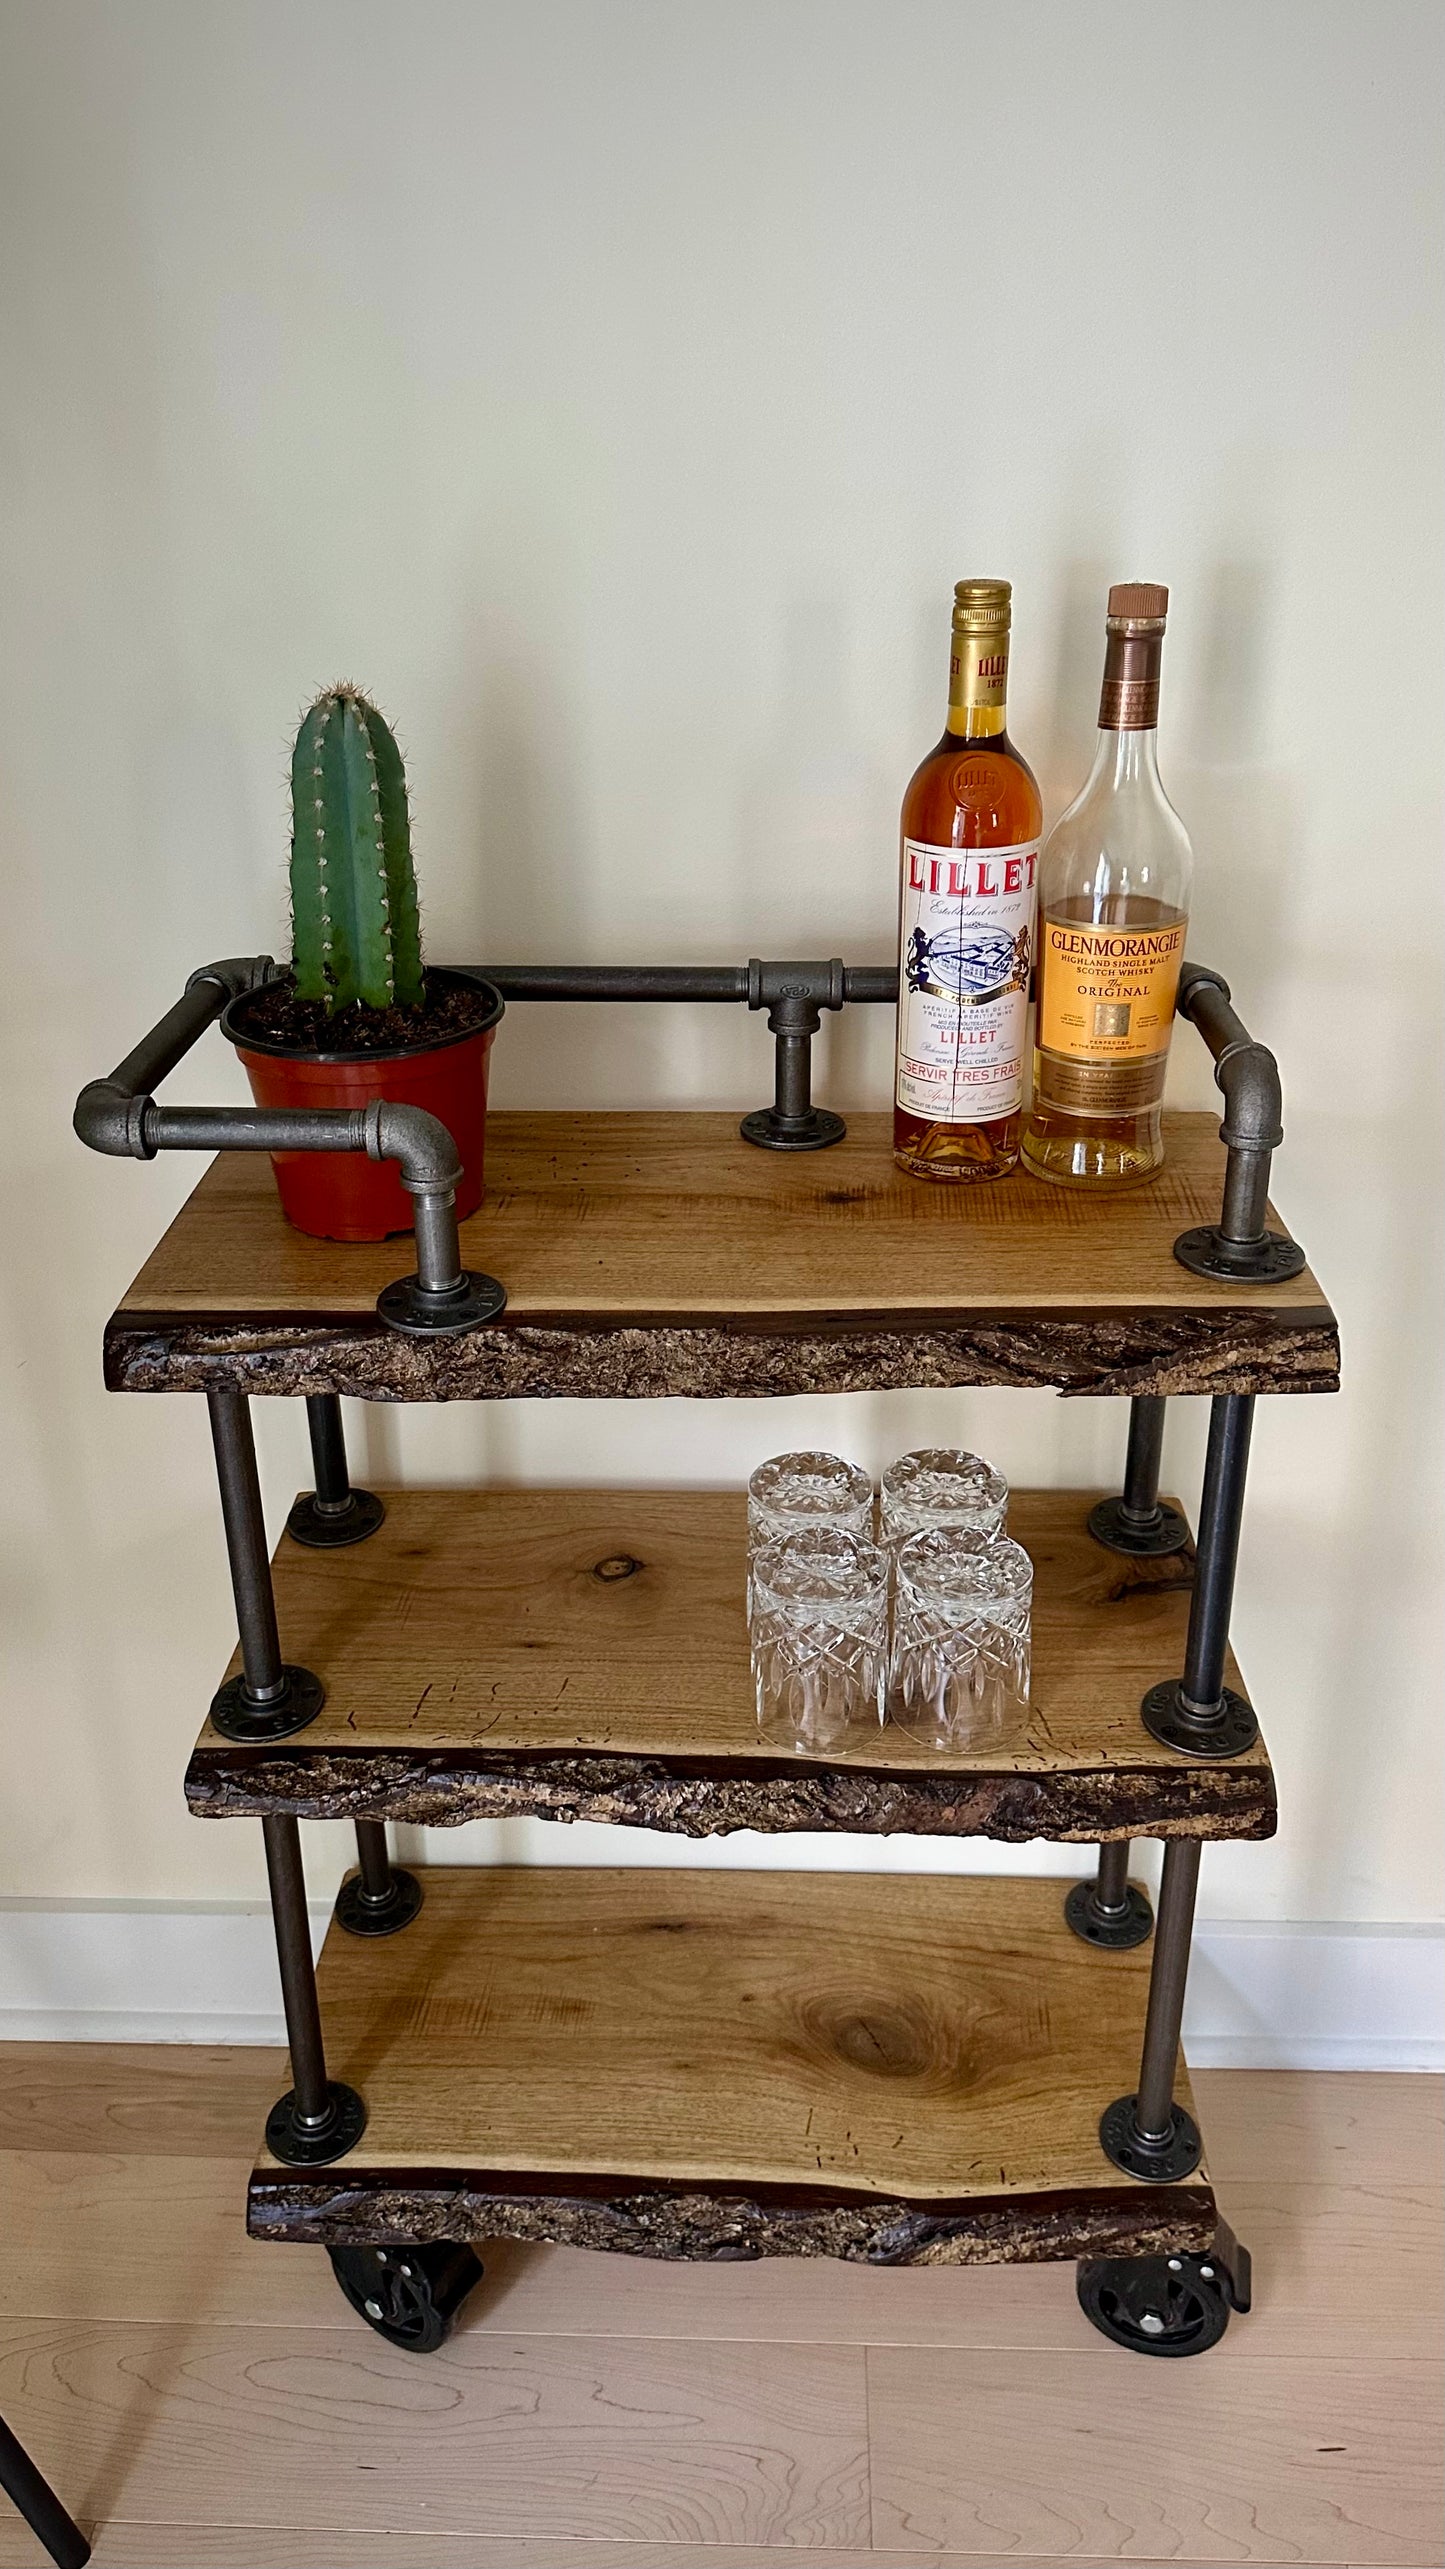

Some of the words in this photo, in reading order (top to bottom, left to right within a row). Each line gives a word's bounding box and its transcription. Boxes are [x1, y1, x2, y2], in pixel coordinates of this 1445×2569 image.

[909, 852, 1038, 898] LILLET
[1051, 931, 1180, 957] GLENMORANGIE
[1061, 954, 1110, 967] HIGHLAND
[1113, 959, 1147, 968] SINGLE
[1149, 955, 1170, 966] MALT
[1076, 966, 1117, 977] SCOTCH
[1119, 966, 1154, 977] WHISKY
[1077, 985, 1151, 998] ORIGINAL
[924, 1010, 953, 1019] FRENCH
[941, 1030, 997, 1045] LILLET
[905, 1061, 947, 1081] SERVIR
[954, 1070, 990, 1082] TRES
[993, 1060, 1021, 1079] FRAIS
